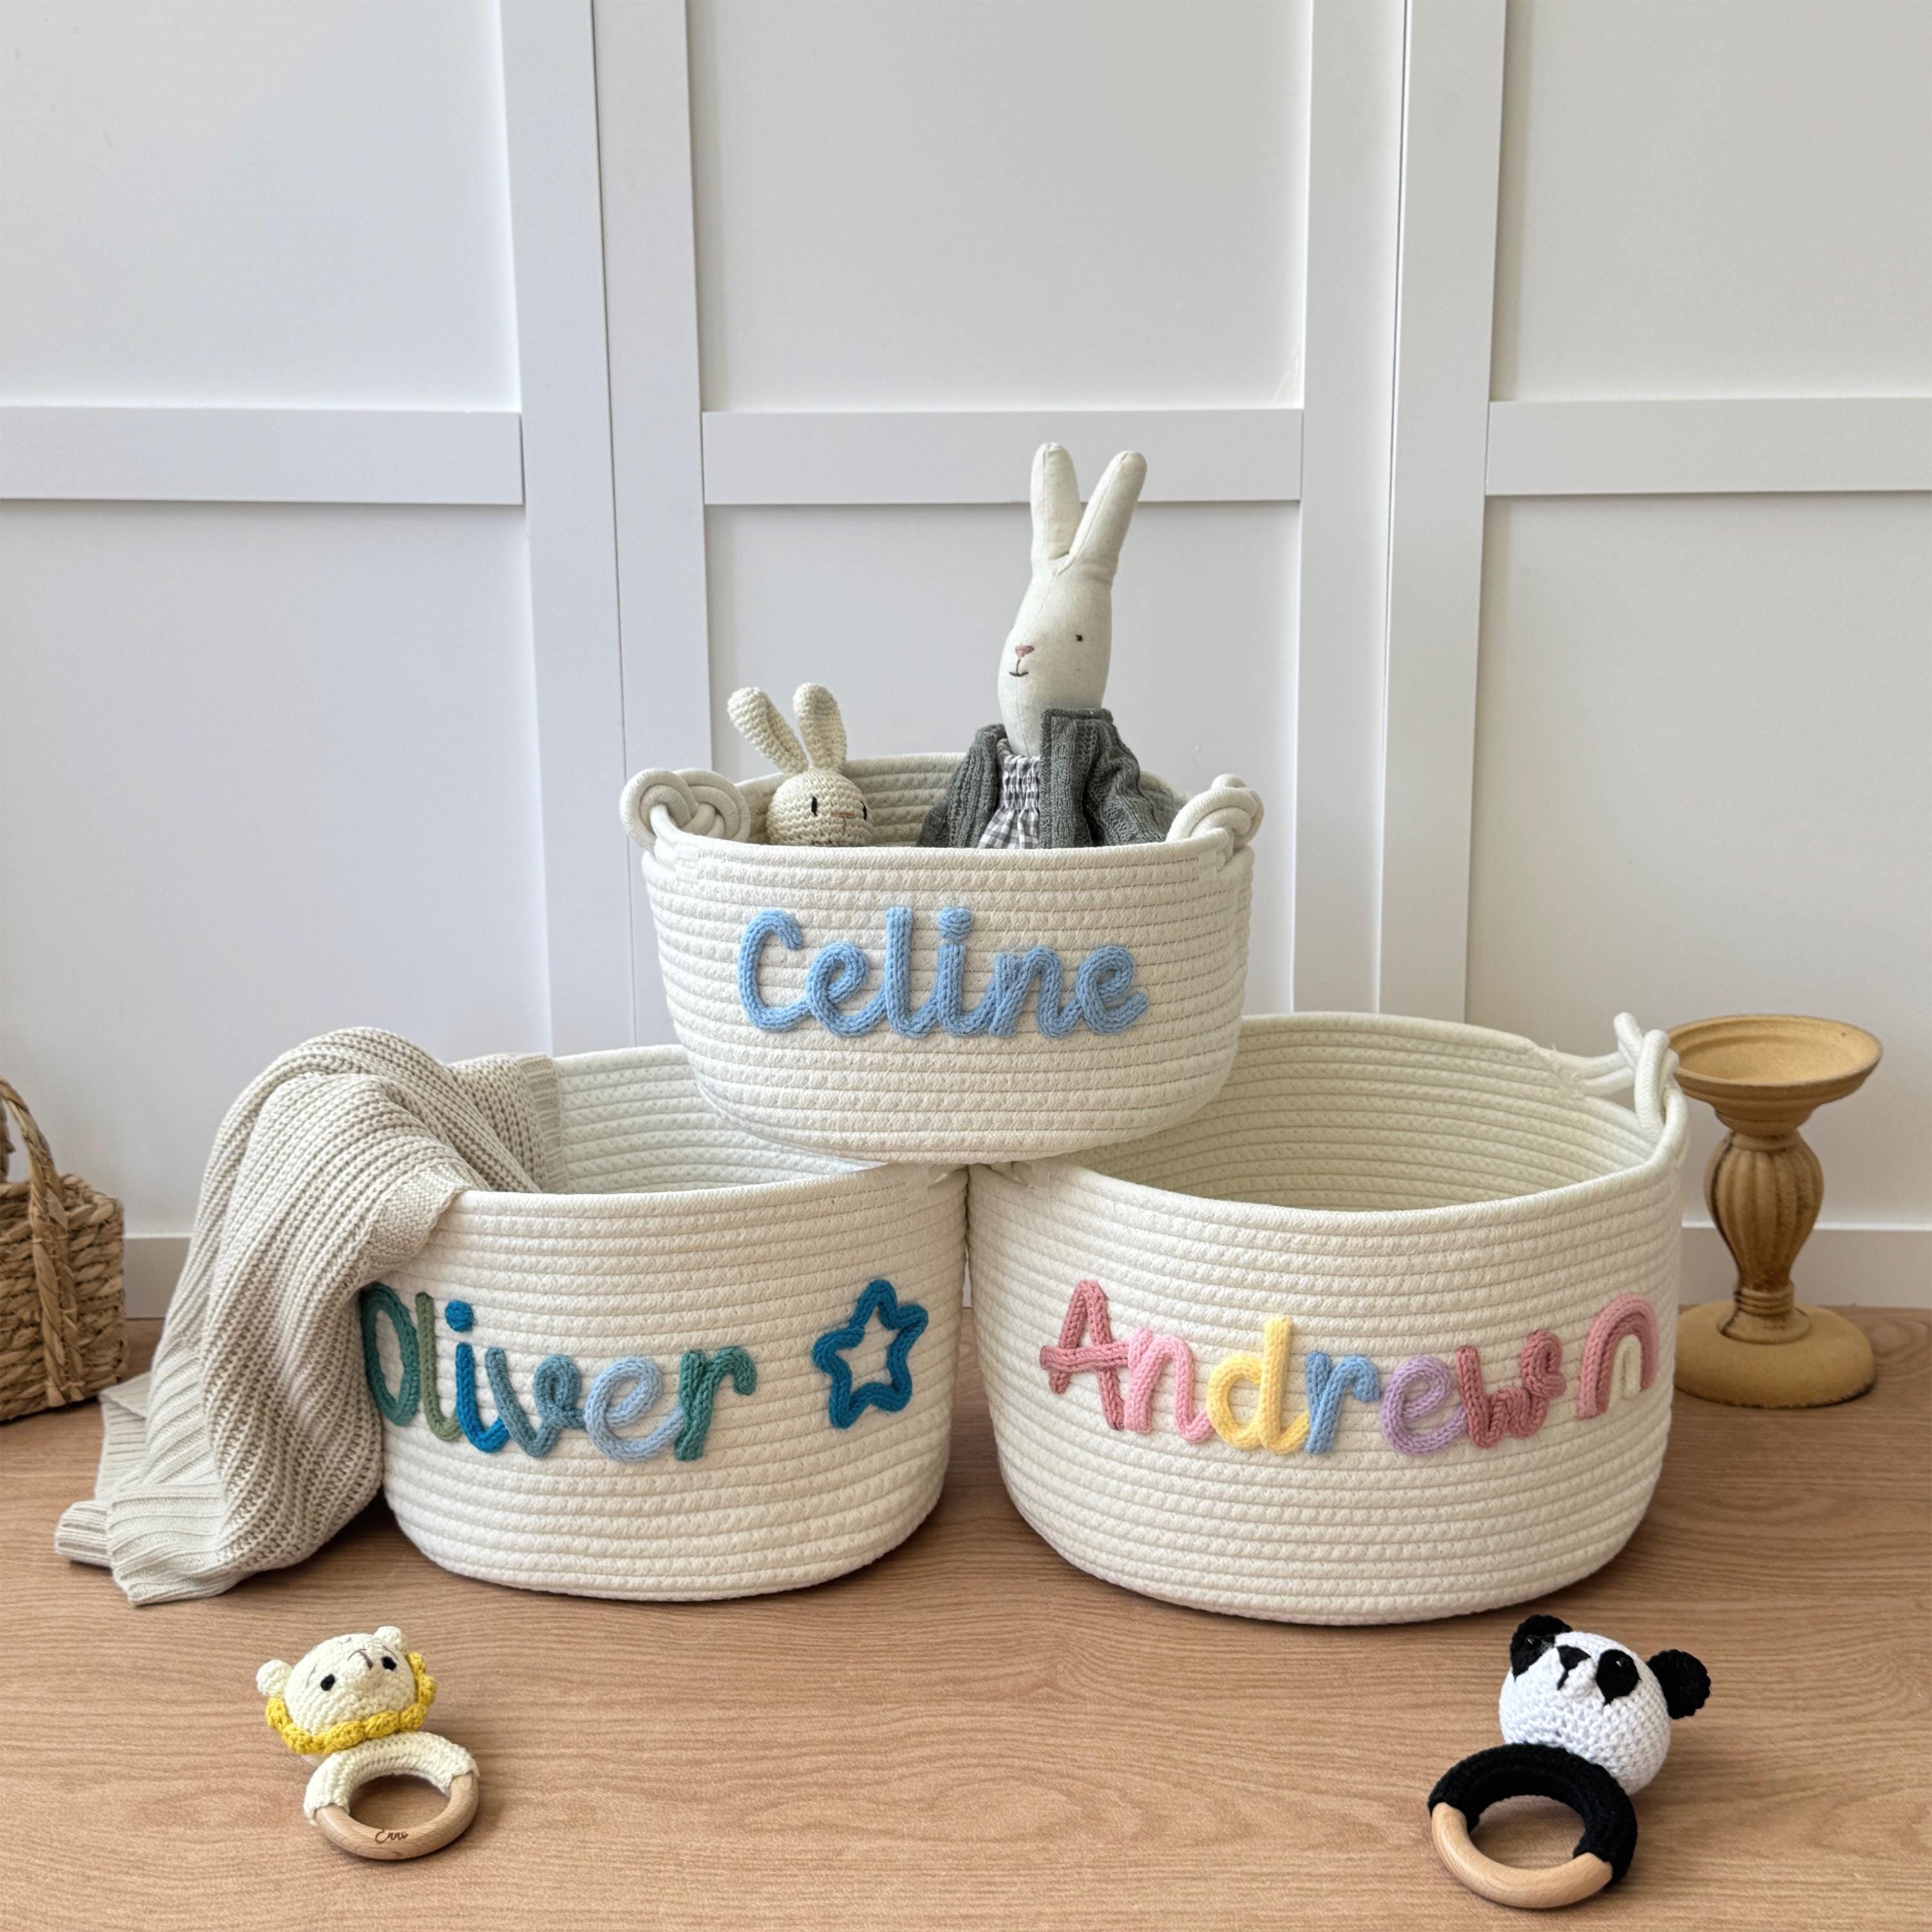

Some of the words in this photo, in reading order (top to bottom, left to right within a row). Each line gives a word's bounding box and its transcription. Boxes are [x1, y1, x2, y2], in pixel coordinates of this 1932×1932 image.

[737, 906, 1150, 1039] Celine
[359, 1281, 757, 1463] Oliver
[1039, 1280, 1567, 1455] Andrew
